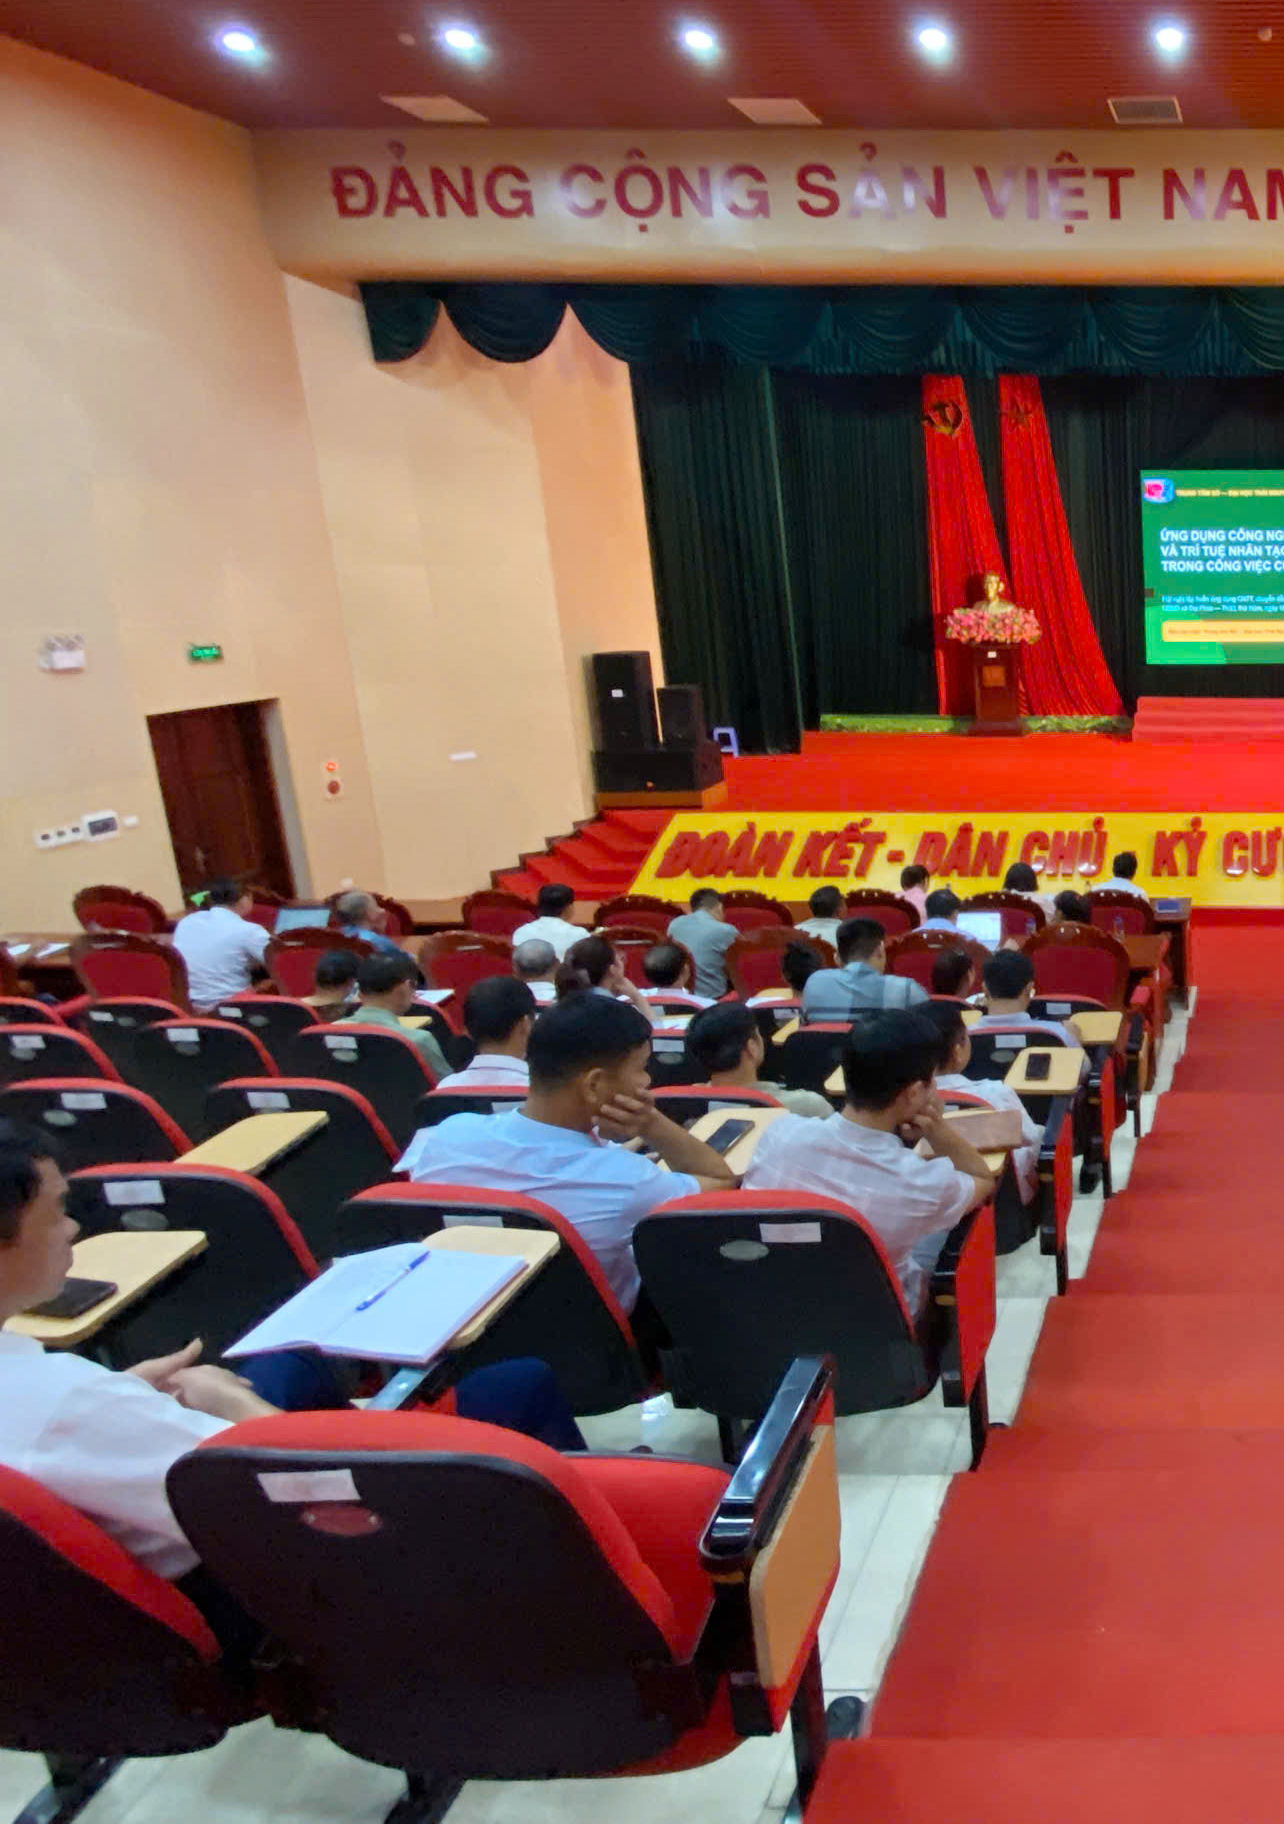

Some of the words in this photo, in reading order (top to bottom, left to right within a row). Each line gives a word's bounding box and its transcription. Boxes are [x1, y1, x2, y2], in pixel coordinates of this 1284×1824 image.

[330, 142, 535, 219] ĐẢNG
[560, 148, 771, 233] CỘNG
[797, 142, 948, 219] SẢN
[975, 150, 1134, 234] VIỆT
[1160, 527, 1188, 542] ỨNG
[1190, 529, 1226, 544] DỤNG
[1228, 527, 1263, 542] CÔNG
[1160, 543, 1178, 557] VÀ
[1180, 543, 1200, 557] TRÍ
[1228, 543, 1263, 556] NHÂN
[1161, 560, 1204, 573] TRONG
[1206, 558, 1241, 573] CÔNG
[1243, 560, 1272, 575] VIỆC
[655, 822, 794, 879] ĐOÀN
[793, 817, 886, 878] KẾT
[914, 822, 1009, 877] DÂN
[1020, 816, 1108, 877] CHỦ
[1152, 817, 1207, 877] KỶ
